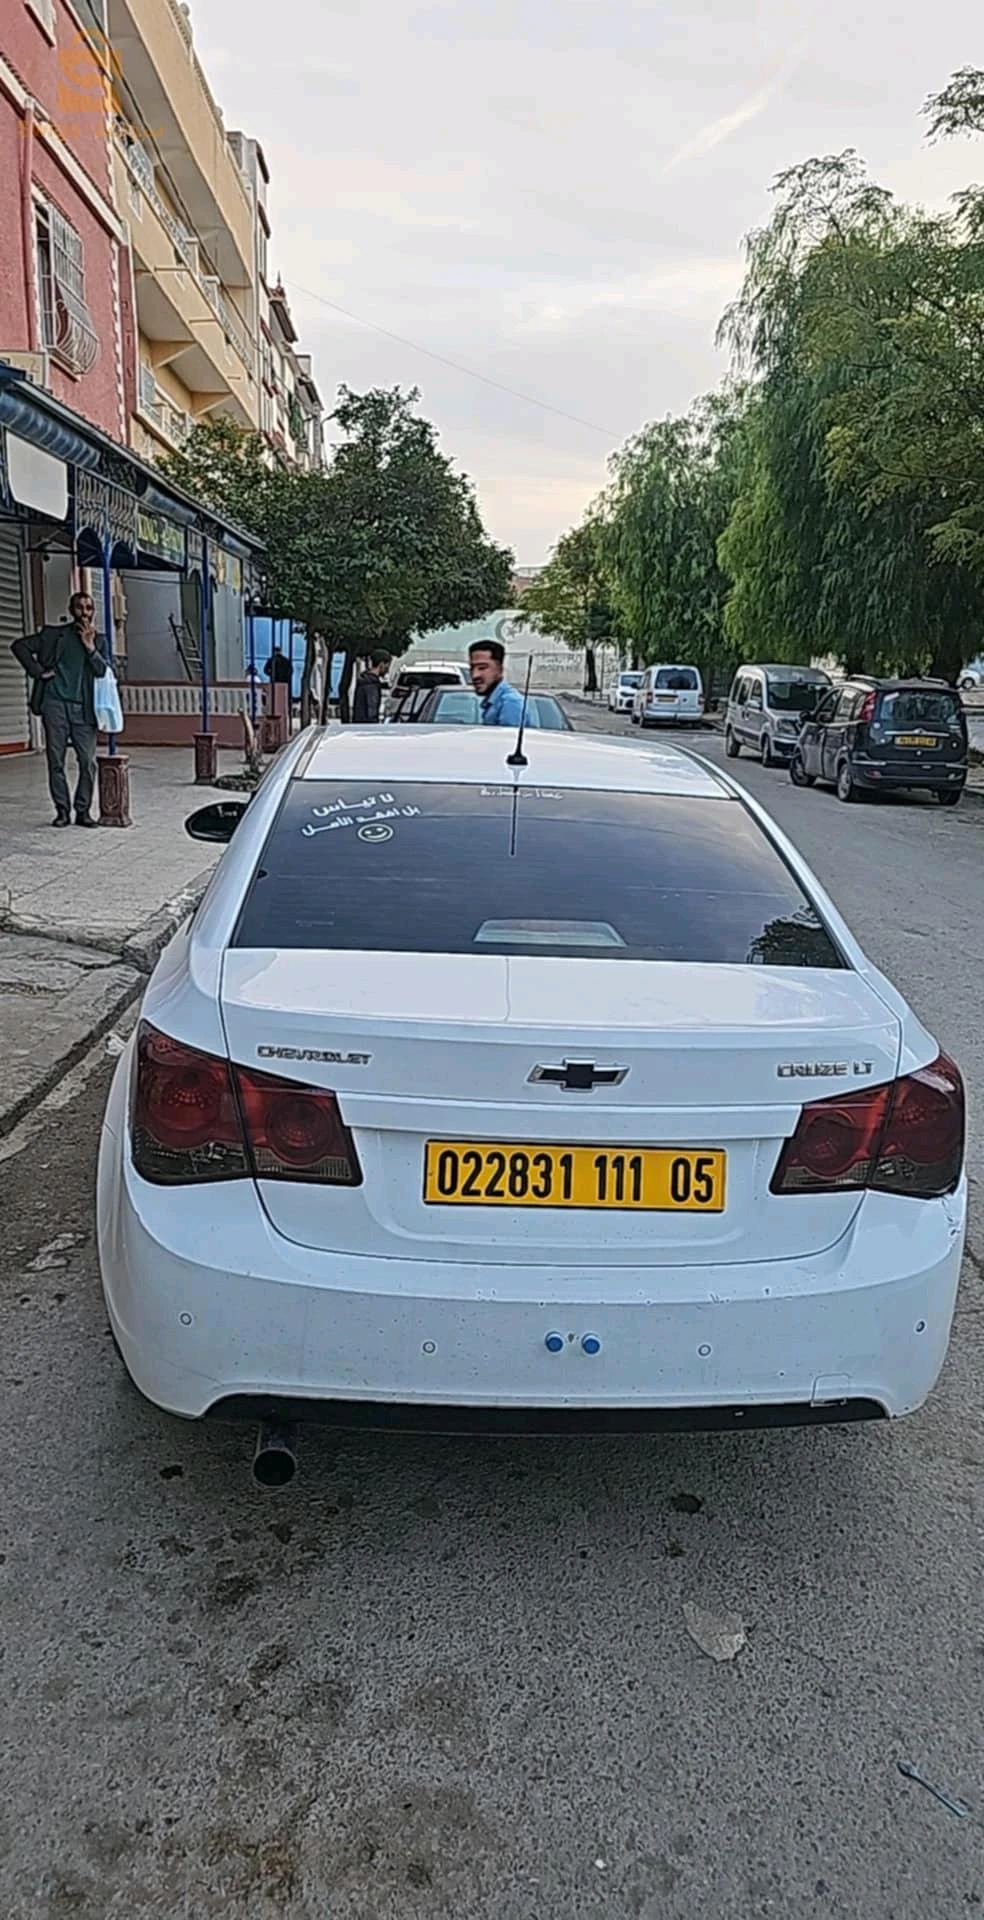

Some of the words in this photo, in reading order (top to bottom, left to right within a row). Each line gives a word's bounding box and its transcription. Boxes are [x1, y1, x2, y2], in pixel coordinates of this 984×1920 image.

[379, 792, 395, 803] لا
[257, 1045, 373, 1065] CHEVROLET
[777, 1062, 848, 1077] CRUZE
[853, 1061, 874, 1075] LT
[437, 1150, 573, 1201] 022831
[594, 1154, 642, 1202] 111
[670, 1157, 714, 1203] 05
